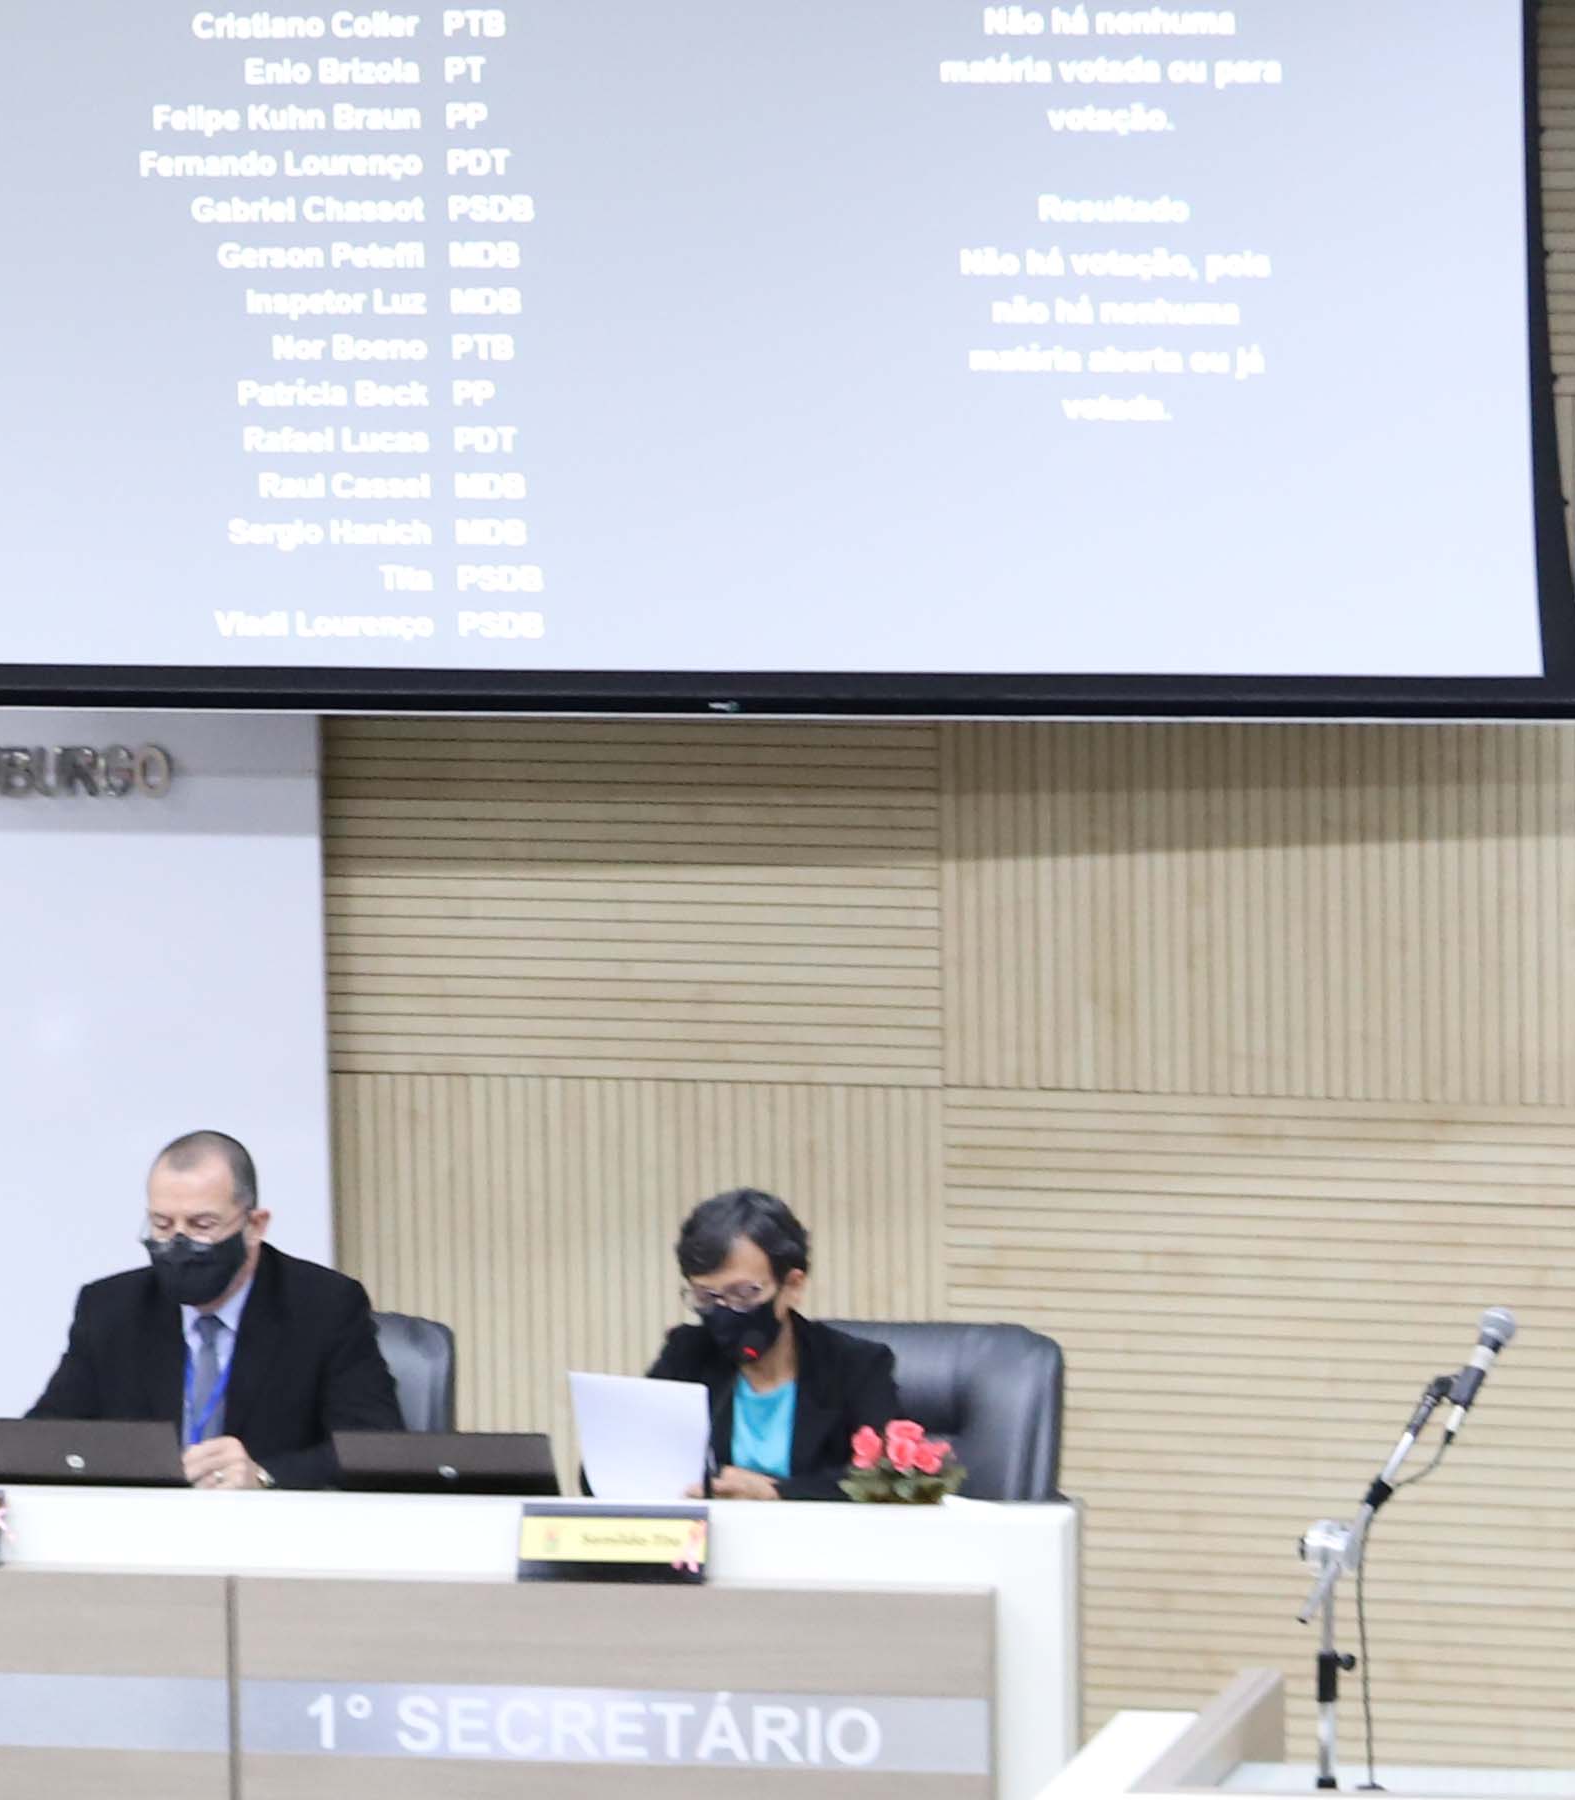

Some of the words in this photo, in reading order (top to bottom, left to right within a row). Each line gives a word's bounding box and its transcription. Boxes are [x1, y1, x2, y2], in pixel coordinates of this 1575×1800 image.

[192, 12, 325, 39] Cristiano
[331, 11, 419, 38] Coller
[443, 10, 505, 37] PTB
[984, 6, 1044, 35] Não
[1051, 4, 1089, 35] há
[1096, 7, 1235, 35] nenhuma
[245, 58, 311, 85] Enio
[319, 57, 420, 84] Brizola
[445, 56, 485, 83] PT
[940, 53, 1051, 83] matéria
[1058, 56, 1160, 83] votada
[1168, 61, 1207, 83] ou
[1215, 61, 1281, 89] para
[153, 105, 240, 137] Felipe
[248, 104, 325, 130] Kuhn
[333, 103, 421, 130] Braun
[446, 102, 487, 129] PP
[1047, 103, 1174, 136] votação.
[139, 151, 277, 177] Fernando
[284, 151, 423, 180] Lourenço
[447, 149, 510, 176] PDT
[191, 196, 295, 222] Gabriel
[303, 196, 424, 222] Chassot
[448, 195, 534, 222] PSDB
[1038, 195, 1189, 222] Resultado
[217, 243, 324, 268] Gerson
[331, 242, 424, 268] Peteffi
[449, 242, 520, 268] MDB
[960, 247, 1020, 276] Não
[1026, 246, 1064, 276] há
[1070, 248, 1198, 281] votação,
[1206, 250, 1271, 283] pois
[246, 289, 367, 320] Inspetor
[373, 288, 427, 314] Luz
[450, 288, 521, 314] MDB
[992, 296, 1049, 324] não
[1055, 294, 1093, 324] há
[1100, 298, 1240, 325] nenhuma
[273, 335, 326, 360] Nor
[332, 334, 427, 360] Boeno
[452, 334, 514, 360] PTB
[1189, 352, 1230, 373] ou
[1235, 344, 1264, 380] já
[355, 380, 429, 407] Beck
[453, 380, 495, 406] PP
[243, 426, 334, 452] Rafael
[342, 427, 429, 452] Lucas
[454, 426, 517, 452] PDT
[259, 472, 325, 498] Raul
[331, 473, 430, 498] Cassel
[454, 473, 526, 499] MDB
[455, 519, 527, 546] MDB
[458, 565, 544, 592] PSDB
[296, 611, 434, 640] Lourenço
[458, 611, 545, 639] PSDB
[395, 1691, 884, 1766] SECRETÁRIO
